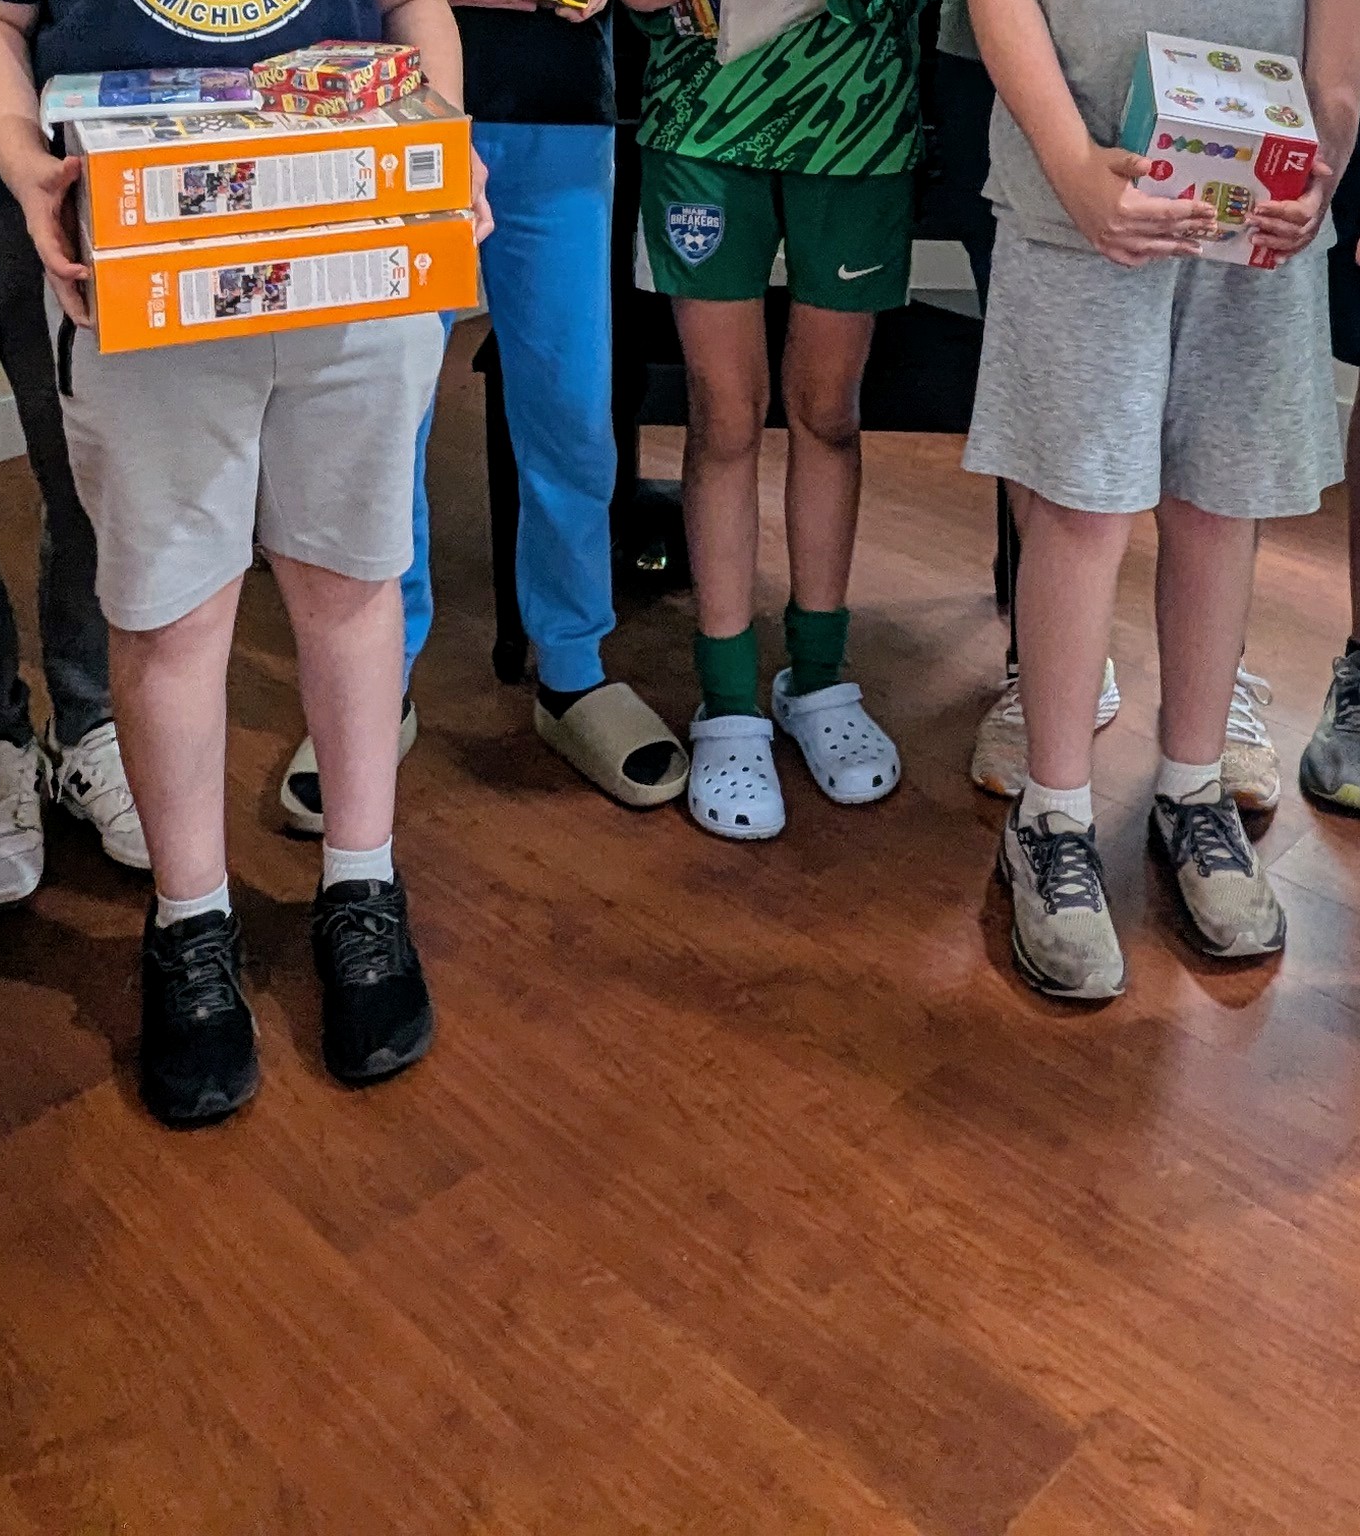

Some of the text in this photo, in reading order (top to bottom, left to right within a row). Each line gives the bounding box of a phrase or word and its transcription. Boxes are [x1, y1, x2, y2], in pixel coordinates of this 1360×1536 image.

[253, 67, 288, 89] UNO
[350, 63, 375, 95] UNO
[313, 96, 349, 117] UNO
[354, 149, 372, 199] VEX
[670, 214, 720, 228] BREAKERS
[388, 249, 406, 297] VEX
